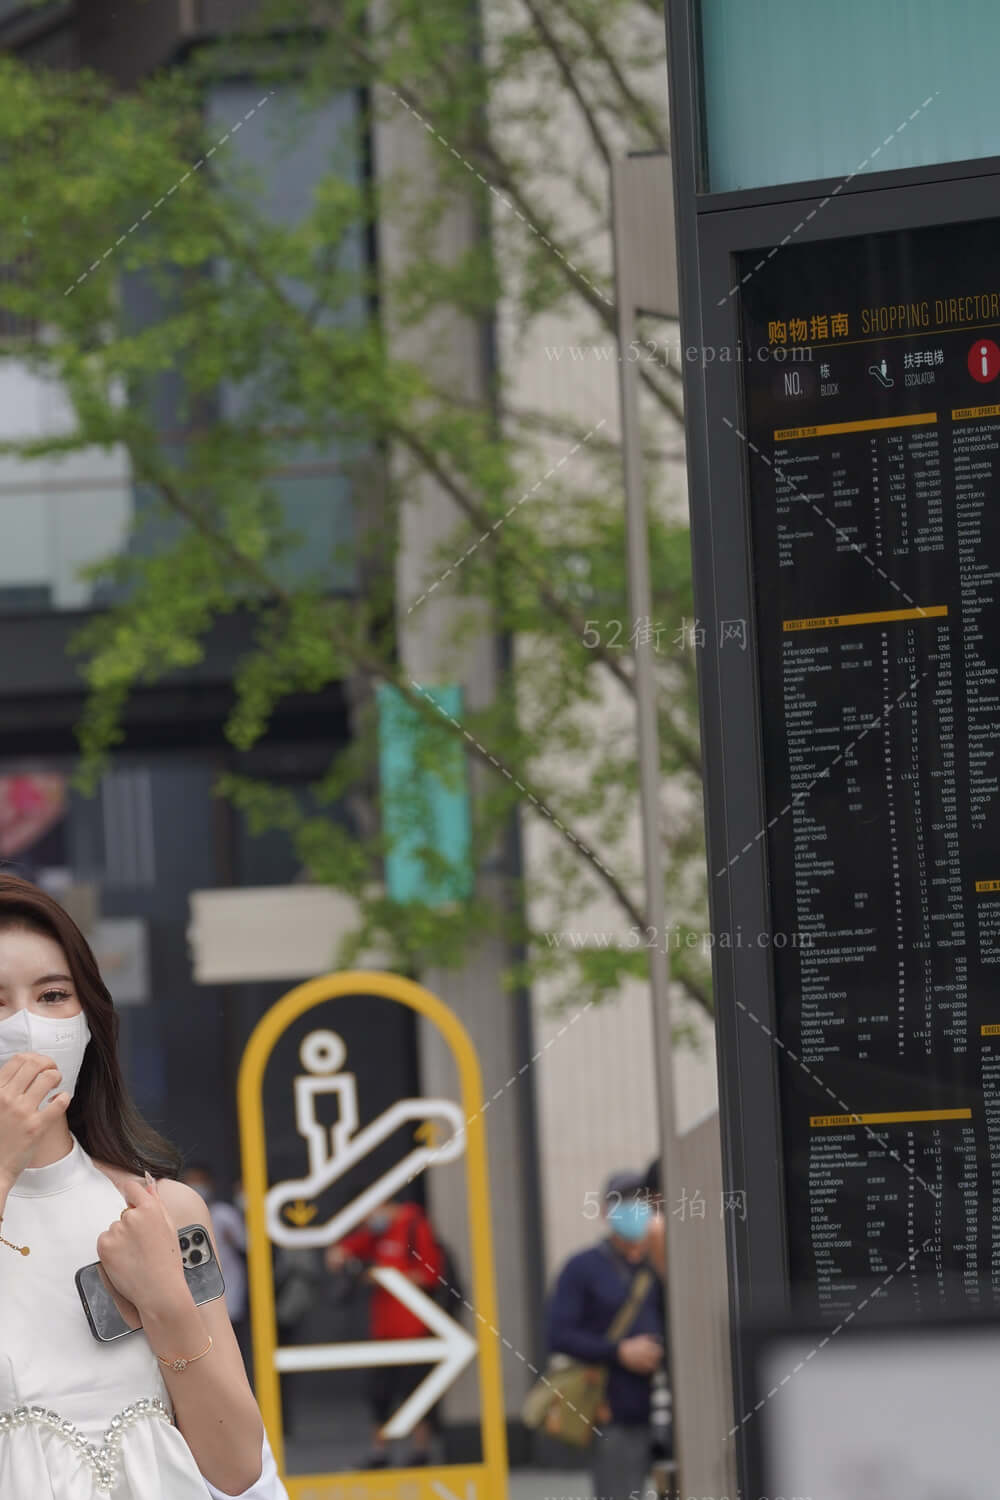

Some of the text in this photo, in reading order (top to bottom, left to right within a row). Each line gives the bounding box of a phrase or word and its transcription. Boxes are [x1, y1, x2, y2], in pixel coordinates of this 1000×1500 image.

[768, 313, 849, 345] 购物指南
[861, 301, 929, 335] SHOPPING
[903, 349, 944, 369] 扶手电梯
[904, 371, 935, 387] ESCALATOR
